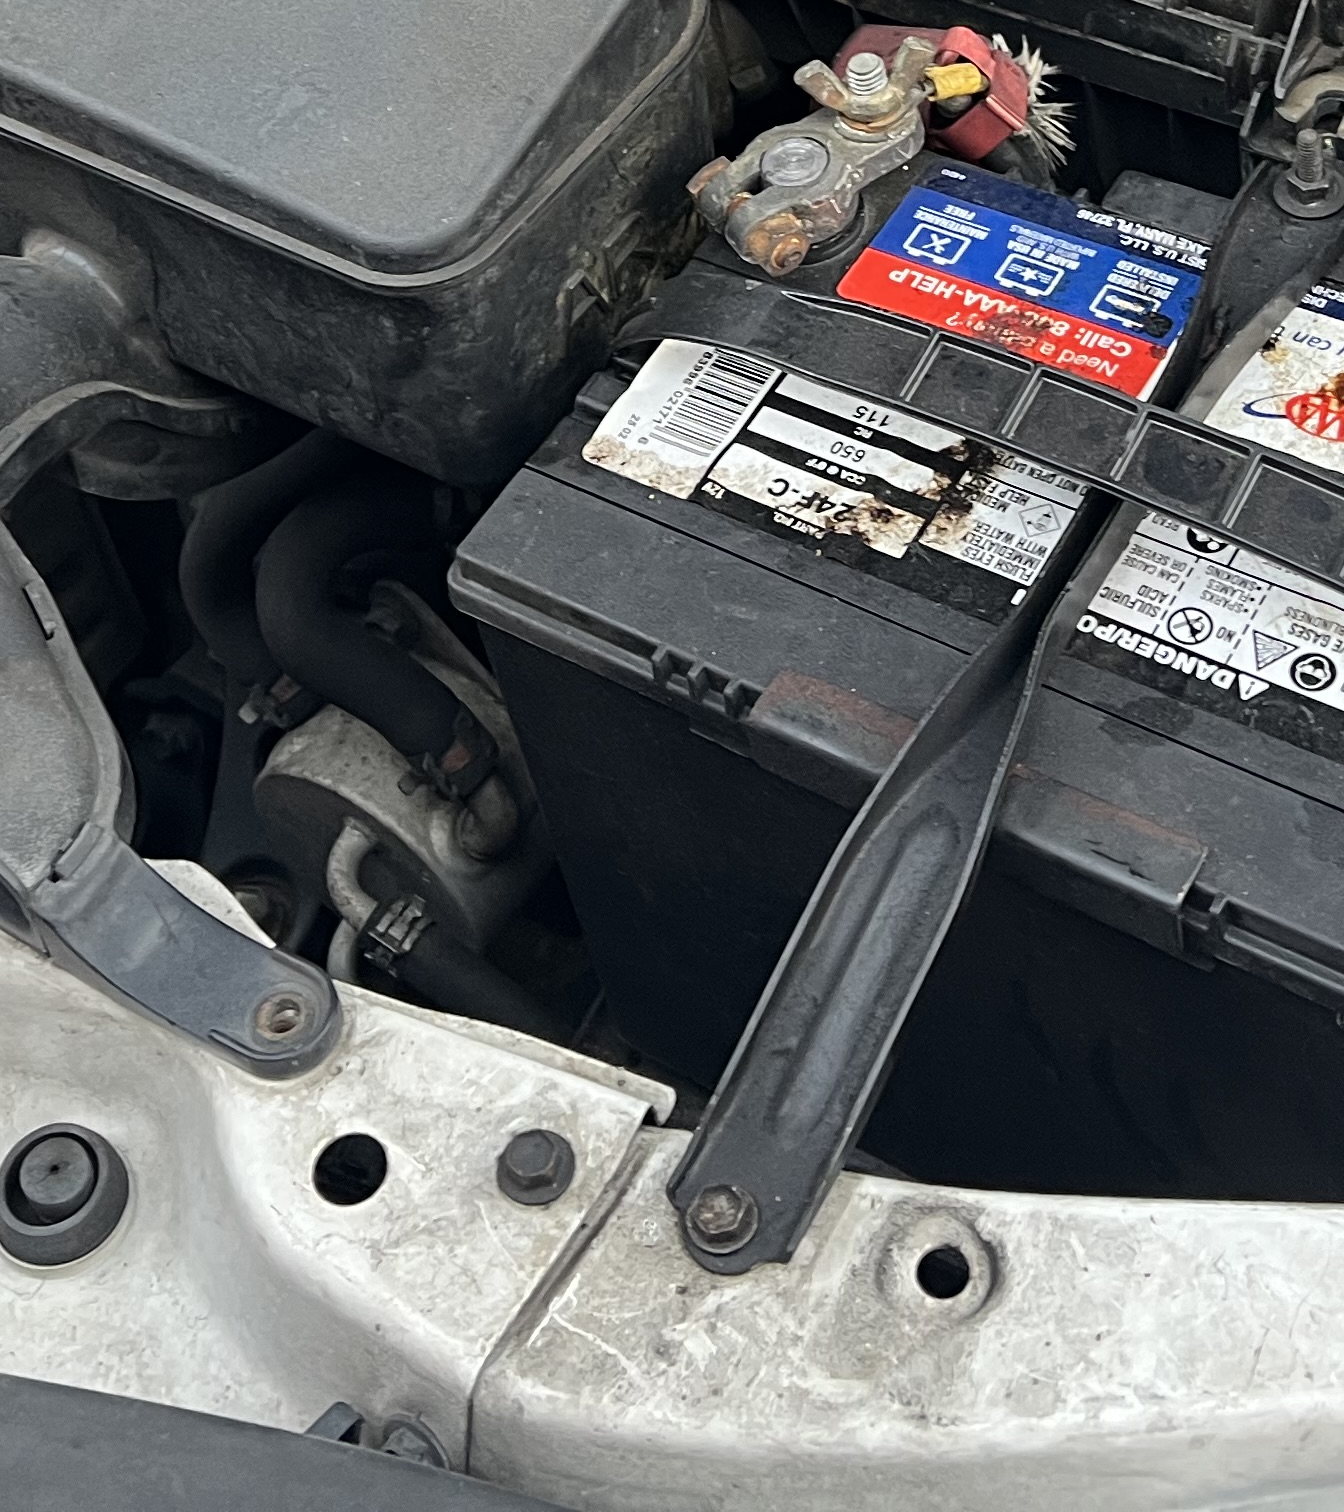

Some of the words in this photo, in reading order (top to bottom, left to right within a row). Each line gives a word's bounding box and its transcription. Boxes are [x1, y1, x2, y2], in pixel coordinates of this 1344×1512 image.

[942, 203, 975, 220] FREE
[912, 208, 987, 240] MAINTENANCE
[1113, 218, 1133, 233] FL
[1006, 239, 1031, 254] USA
[1028, 247, 1046, 259] IN
[1149, 243, 1177, 260] U.S.
[1043, 252, 1080, 270] MADE
[1116, 259, 1178, 286] INSTALLED
[1039, 341, 1055, 355] a
[1074, 326, 1132, 357] Call:
[1291, 330, 1332, 352] can
[1052, 344, 1119, 379] Need
[651, 390, 683, 424] 02171
[852, 404, 890, 427] 115
[829, 440, 865, 463] 650
[839, 470, 865, 485] CCA
[1027, 465, 1056, 483] OPEN
[699, 479, 725, 499] 12V
[766, 476, 855, 522] 24F-C
[999, 487, 1029, 505] HELP
[791, 519, 824, 538] PART
[961, 545, 993, 565] EYES
[1015, 537, 1047, 557] WITH
[1128, 543, 1170, 566] SEVERE
[993, 558, 1033, 581] FLUSH
[1121, 554, 1157, 575] CAUSE
[1171, 559, 1187, 572] OR
[1157, 568, 1179, 583] CAN
[1098, 585, 1161, 617] SULFURIC
[1136, 583, 1168, 604] ACID
[1215, 626, 1236, 643] NO
[1287, 622, 1331, 647] GASES
